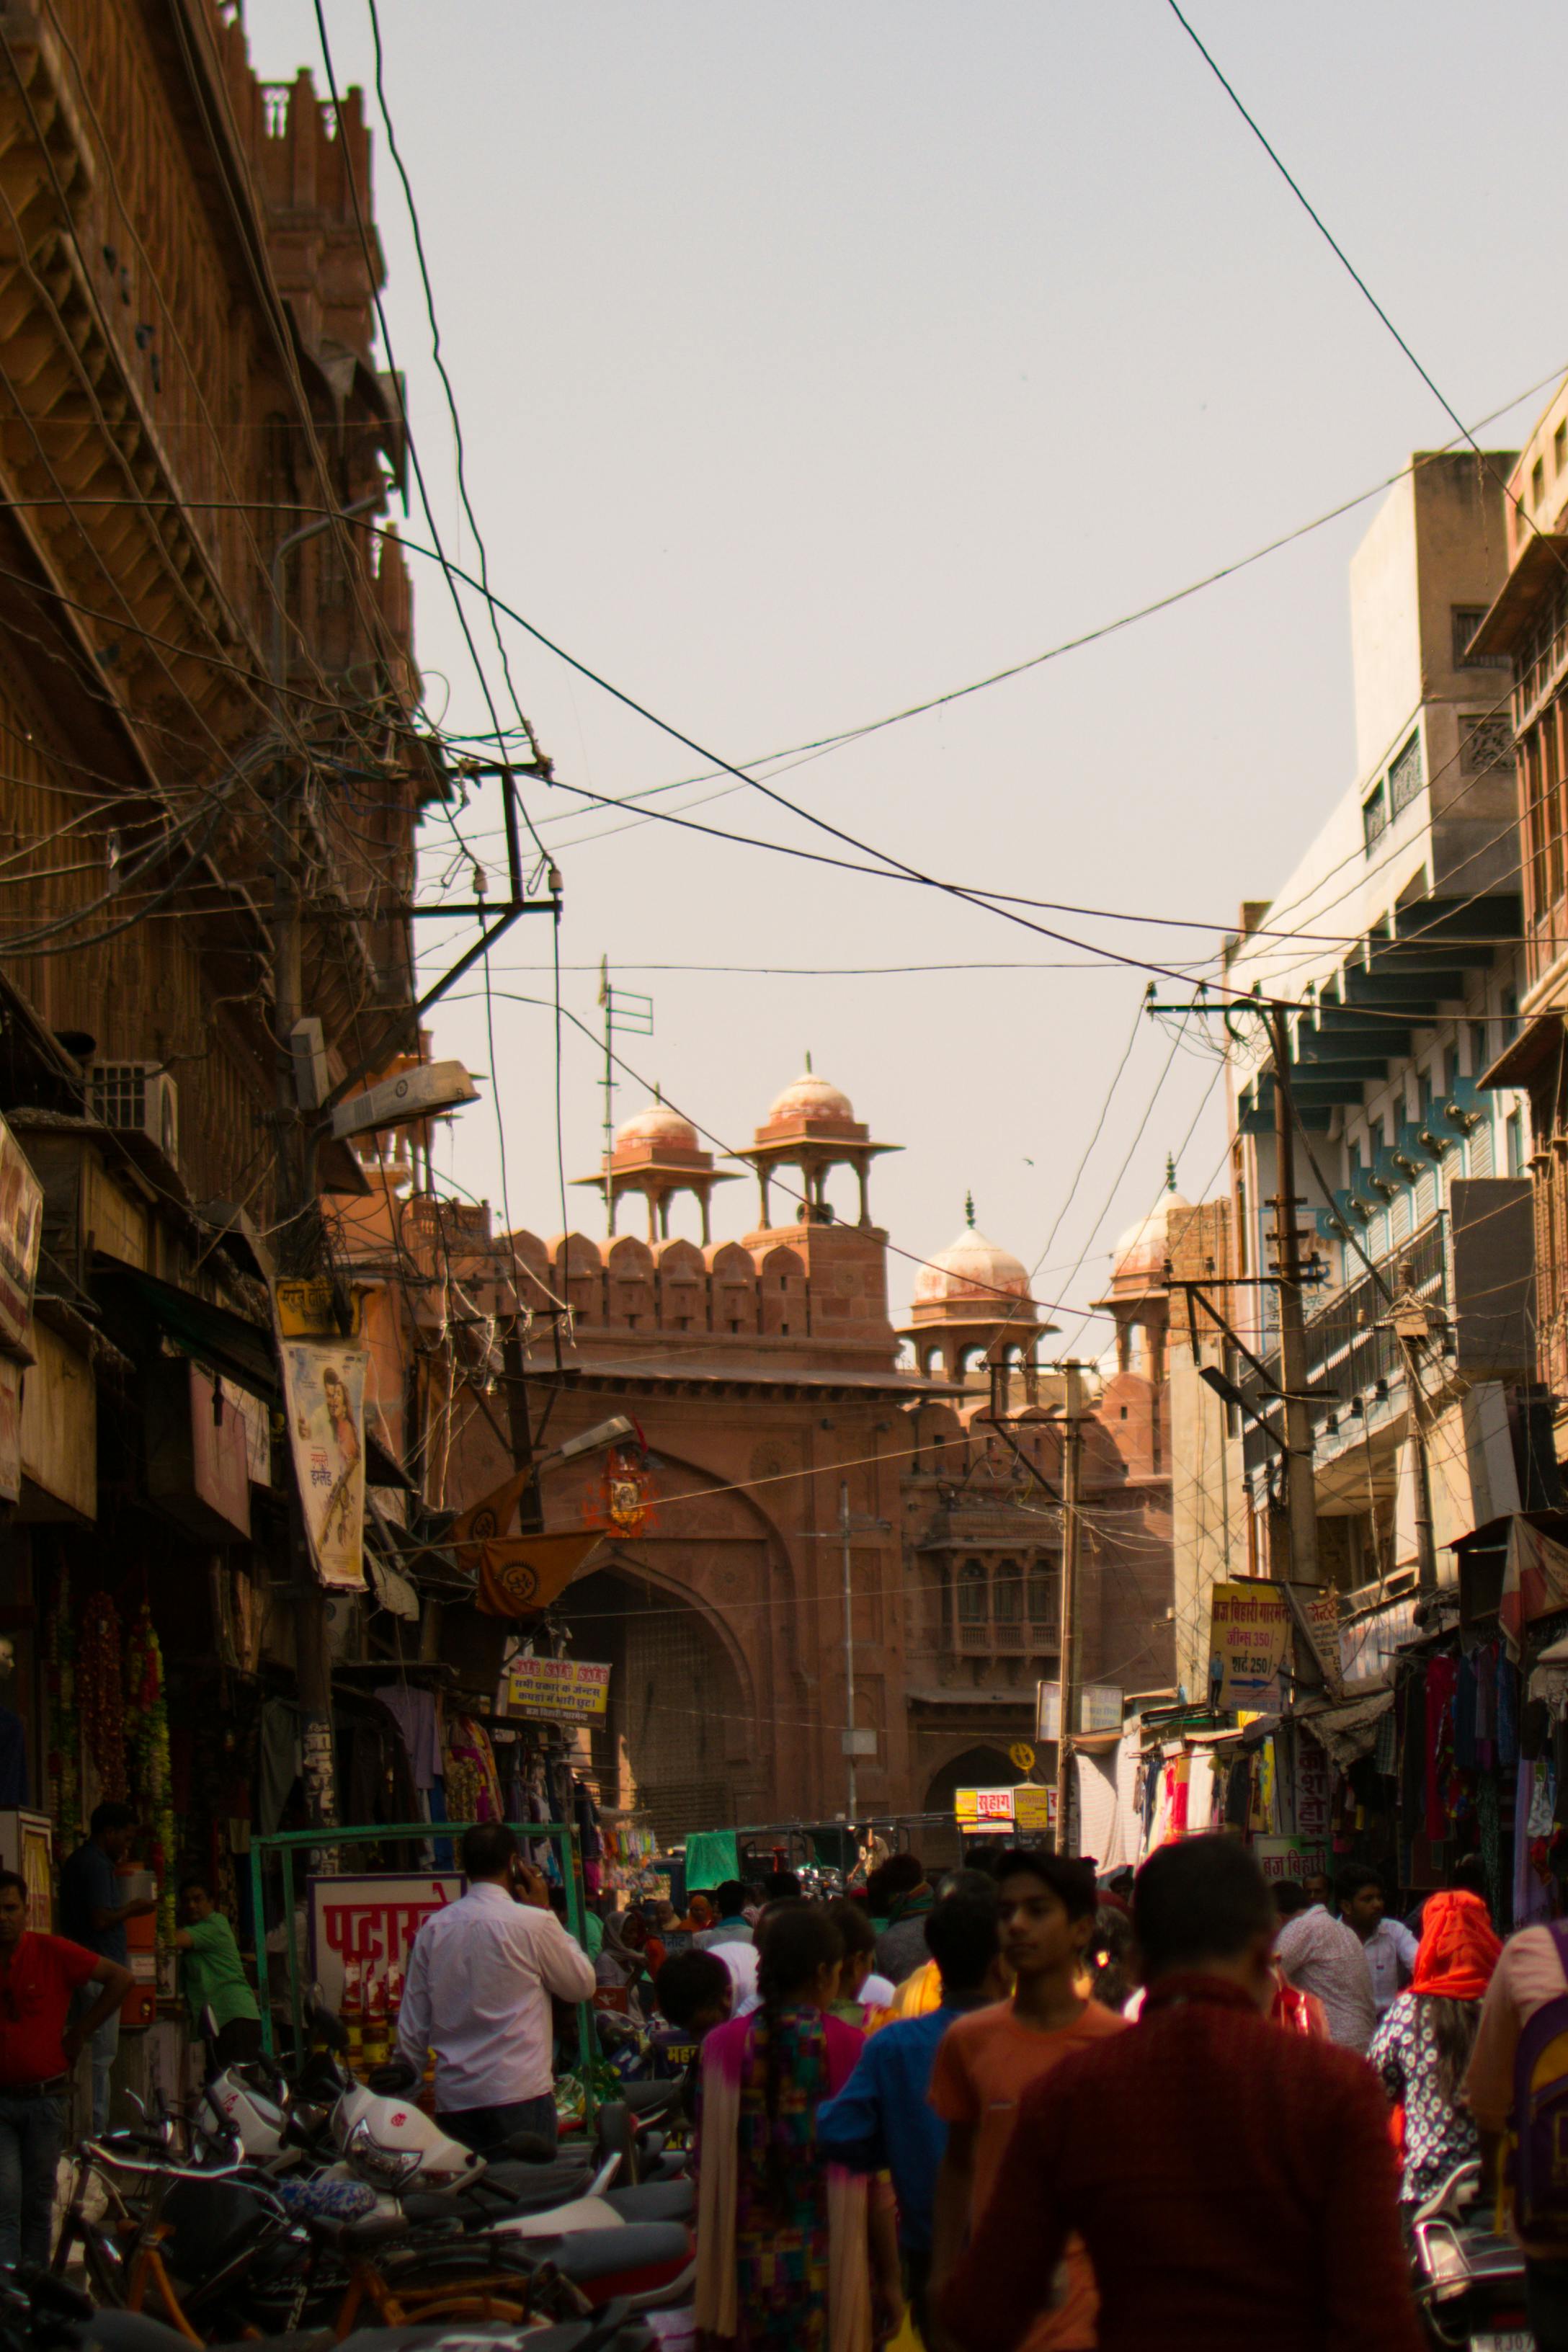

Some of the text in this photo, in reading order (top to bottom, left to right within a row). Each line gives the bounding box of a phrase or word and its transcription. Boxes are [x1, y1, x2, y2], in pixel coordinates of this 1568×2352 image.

[1231, 1595, 1258, 1623] बिहारी
[1226, 1627, 1251, 1647] जीन्स
[545, 1661, 573, 1680] SALE
[577, 1666, 609, 1685] SALE
[1231, 1650, 1249, 1672] शर्ट
[1286, 1849, 1326, 1876] बिहारी
